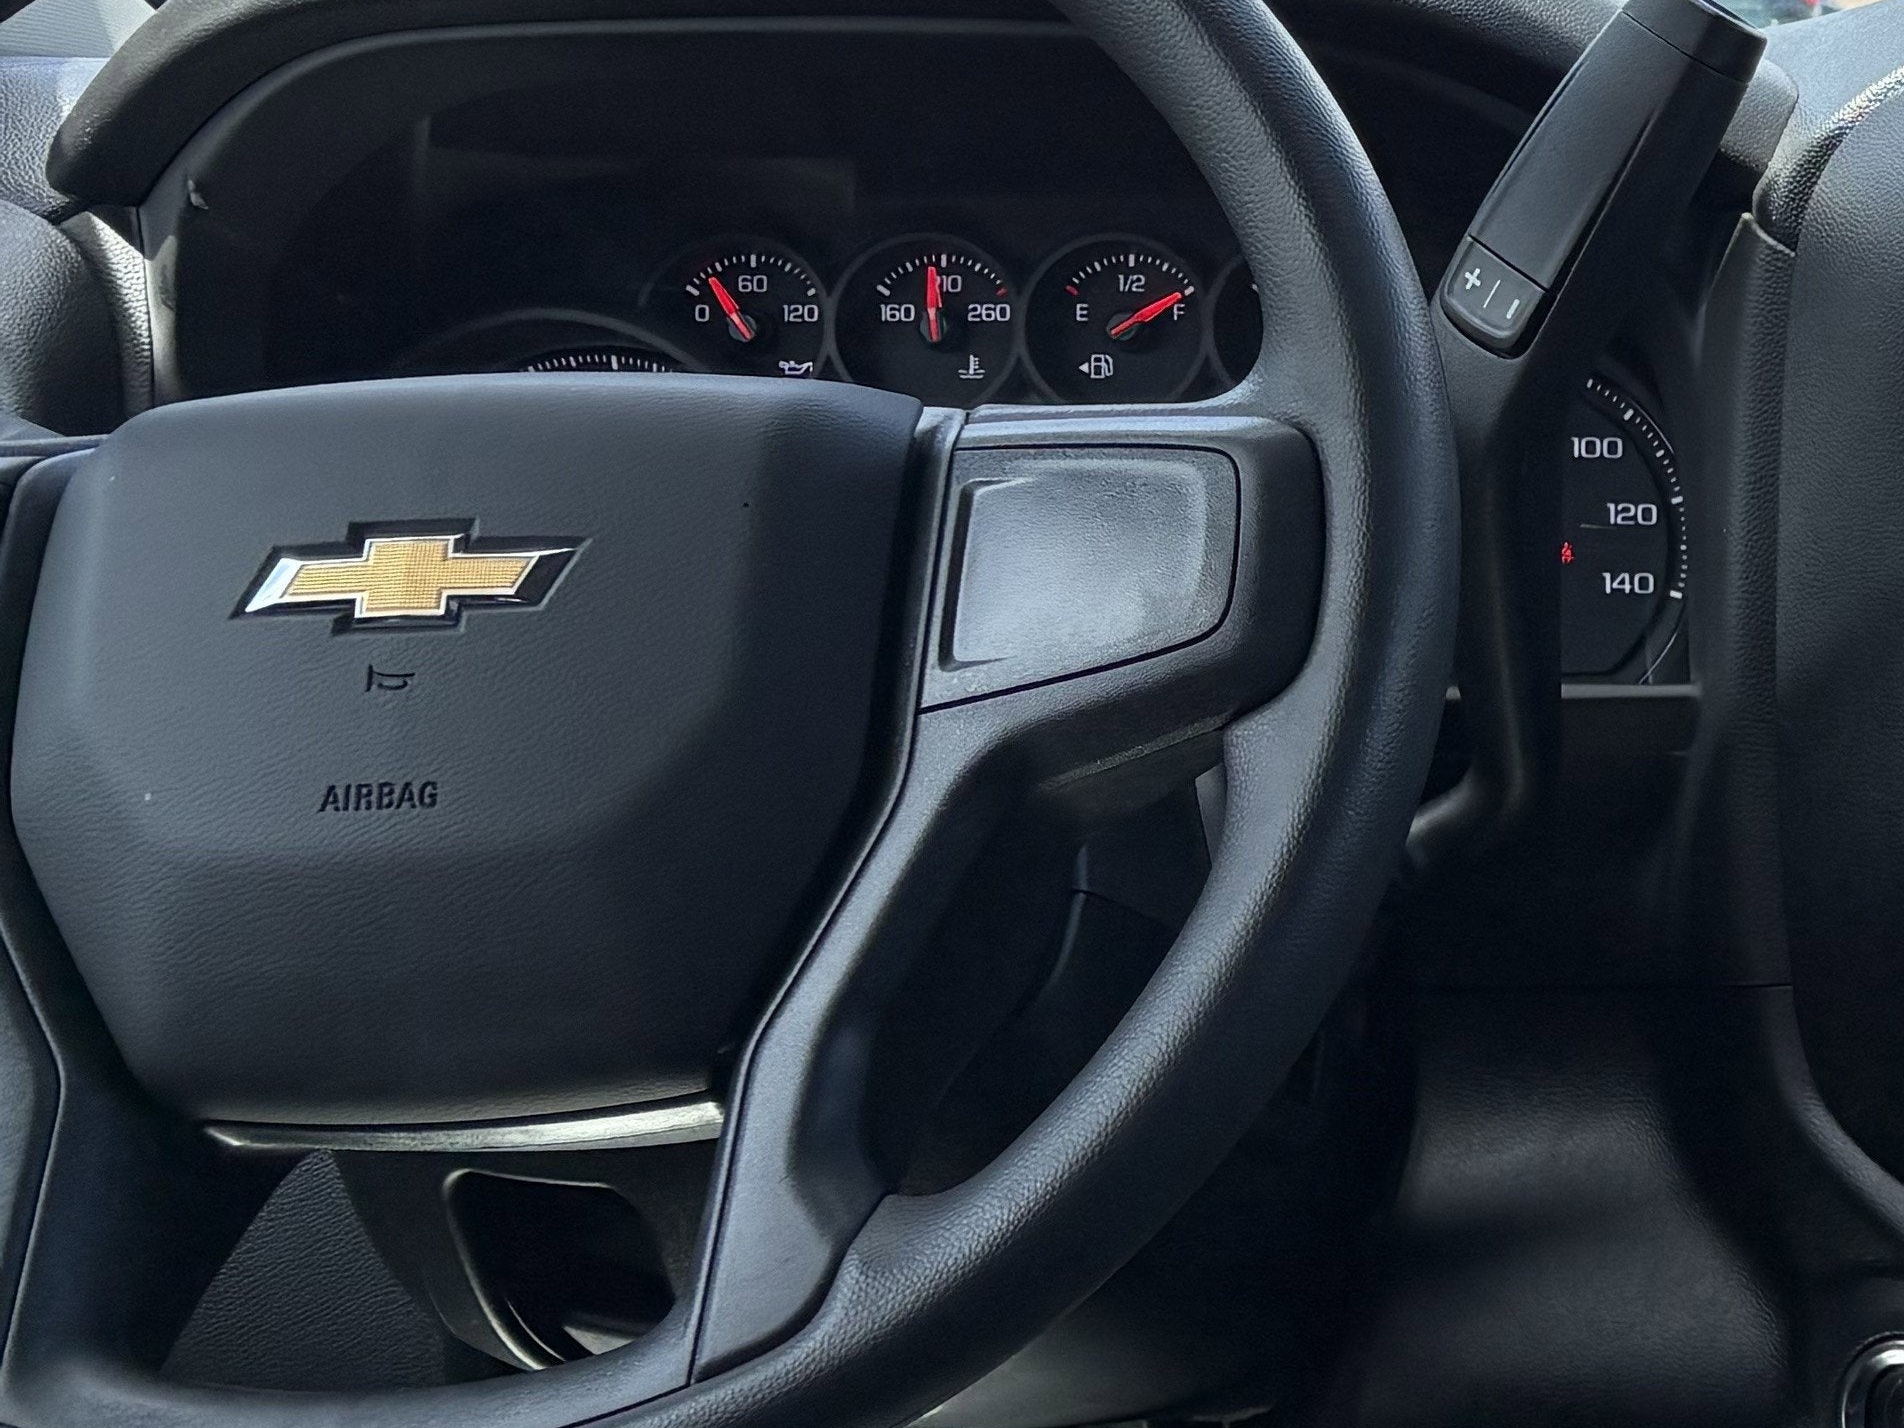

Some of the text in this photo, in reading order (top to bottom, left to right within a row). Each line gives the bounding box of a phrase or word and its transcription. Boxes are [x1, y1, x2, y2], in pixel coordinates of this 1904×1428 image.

[738, 274, 768, 294] 60
[1117, 274, 1146, 294] 1/2
[695, 305, 710, 323] 0
[783, 305, 819, 323] 120
[880, 305, 915, 323] 160
[967, 304, 1011, 323] 260
[1076, 304, 1089, 322] E
[1173, 304, 1186, 322] F
[1571, 436, 1623, 460] 100
[1607, 502, 1658, 526] 120
[1602, 572, 1655, 596] 140
[317, 780, 439, 813] AIRBAG
